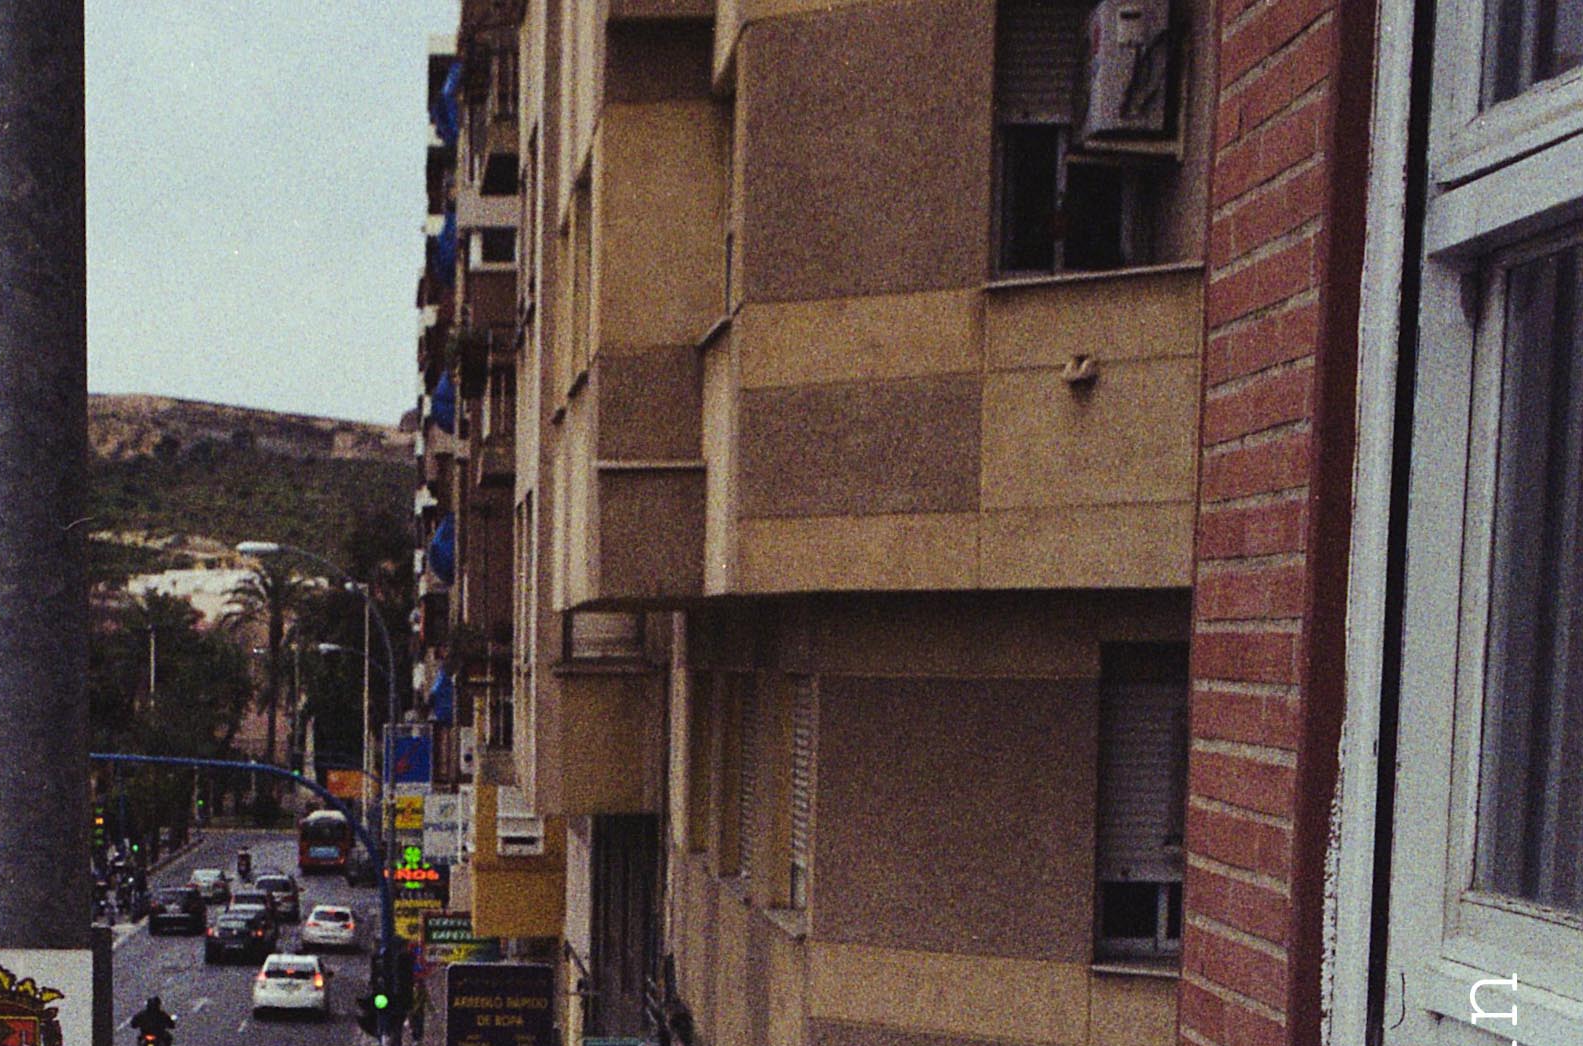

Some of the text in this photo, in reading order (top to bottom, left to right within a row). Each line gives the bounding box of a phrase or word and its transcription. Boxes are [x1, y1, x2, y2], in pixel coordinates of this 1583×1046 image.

[476, 1014, 524, 1027] DE ROPA
[21, 1031, 30, 1046] L
